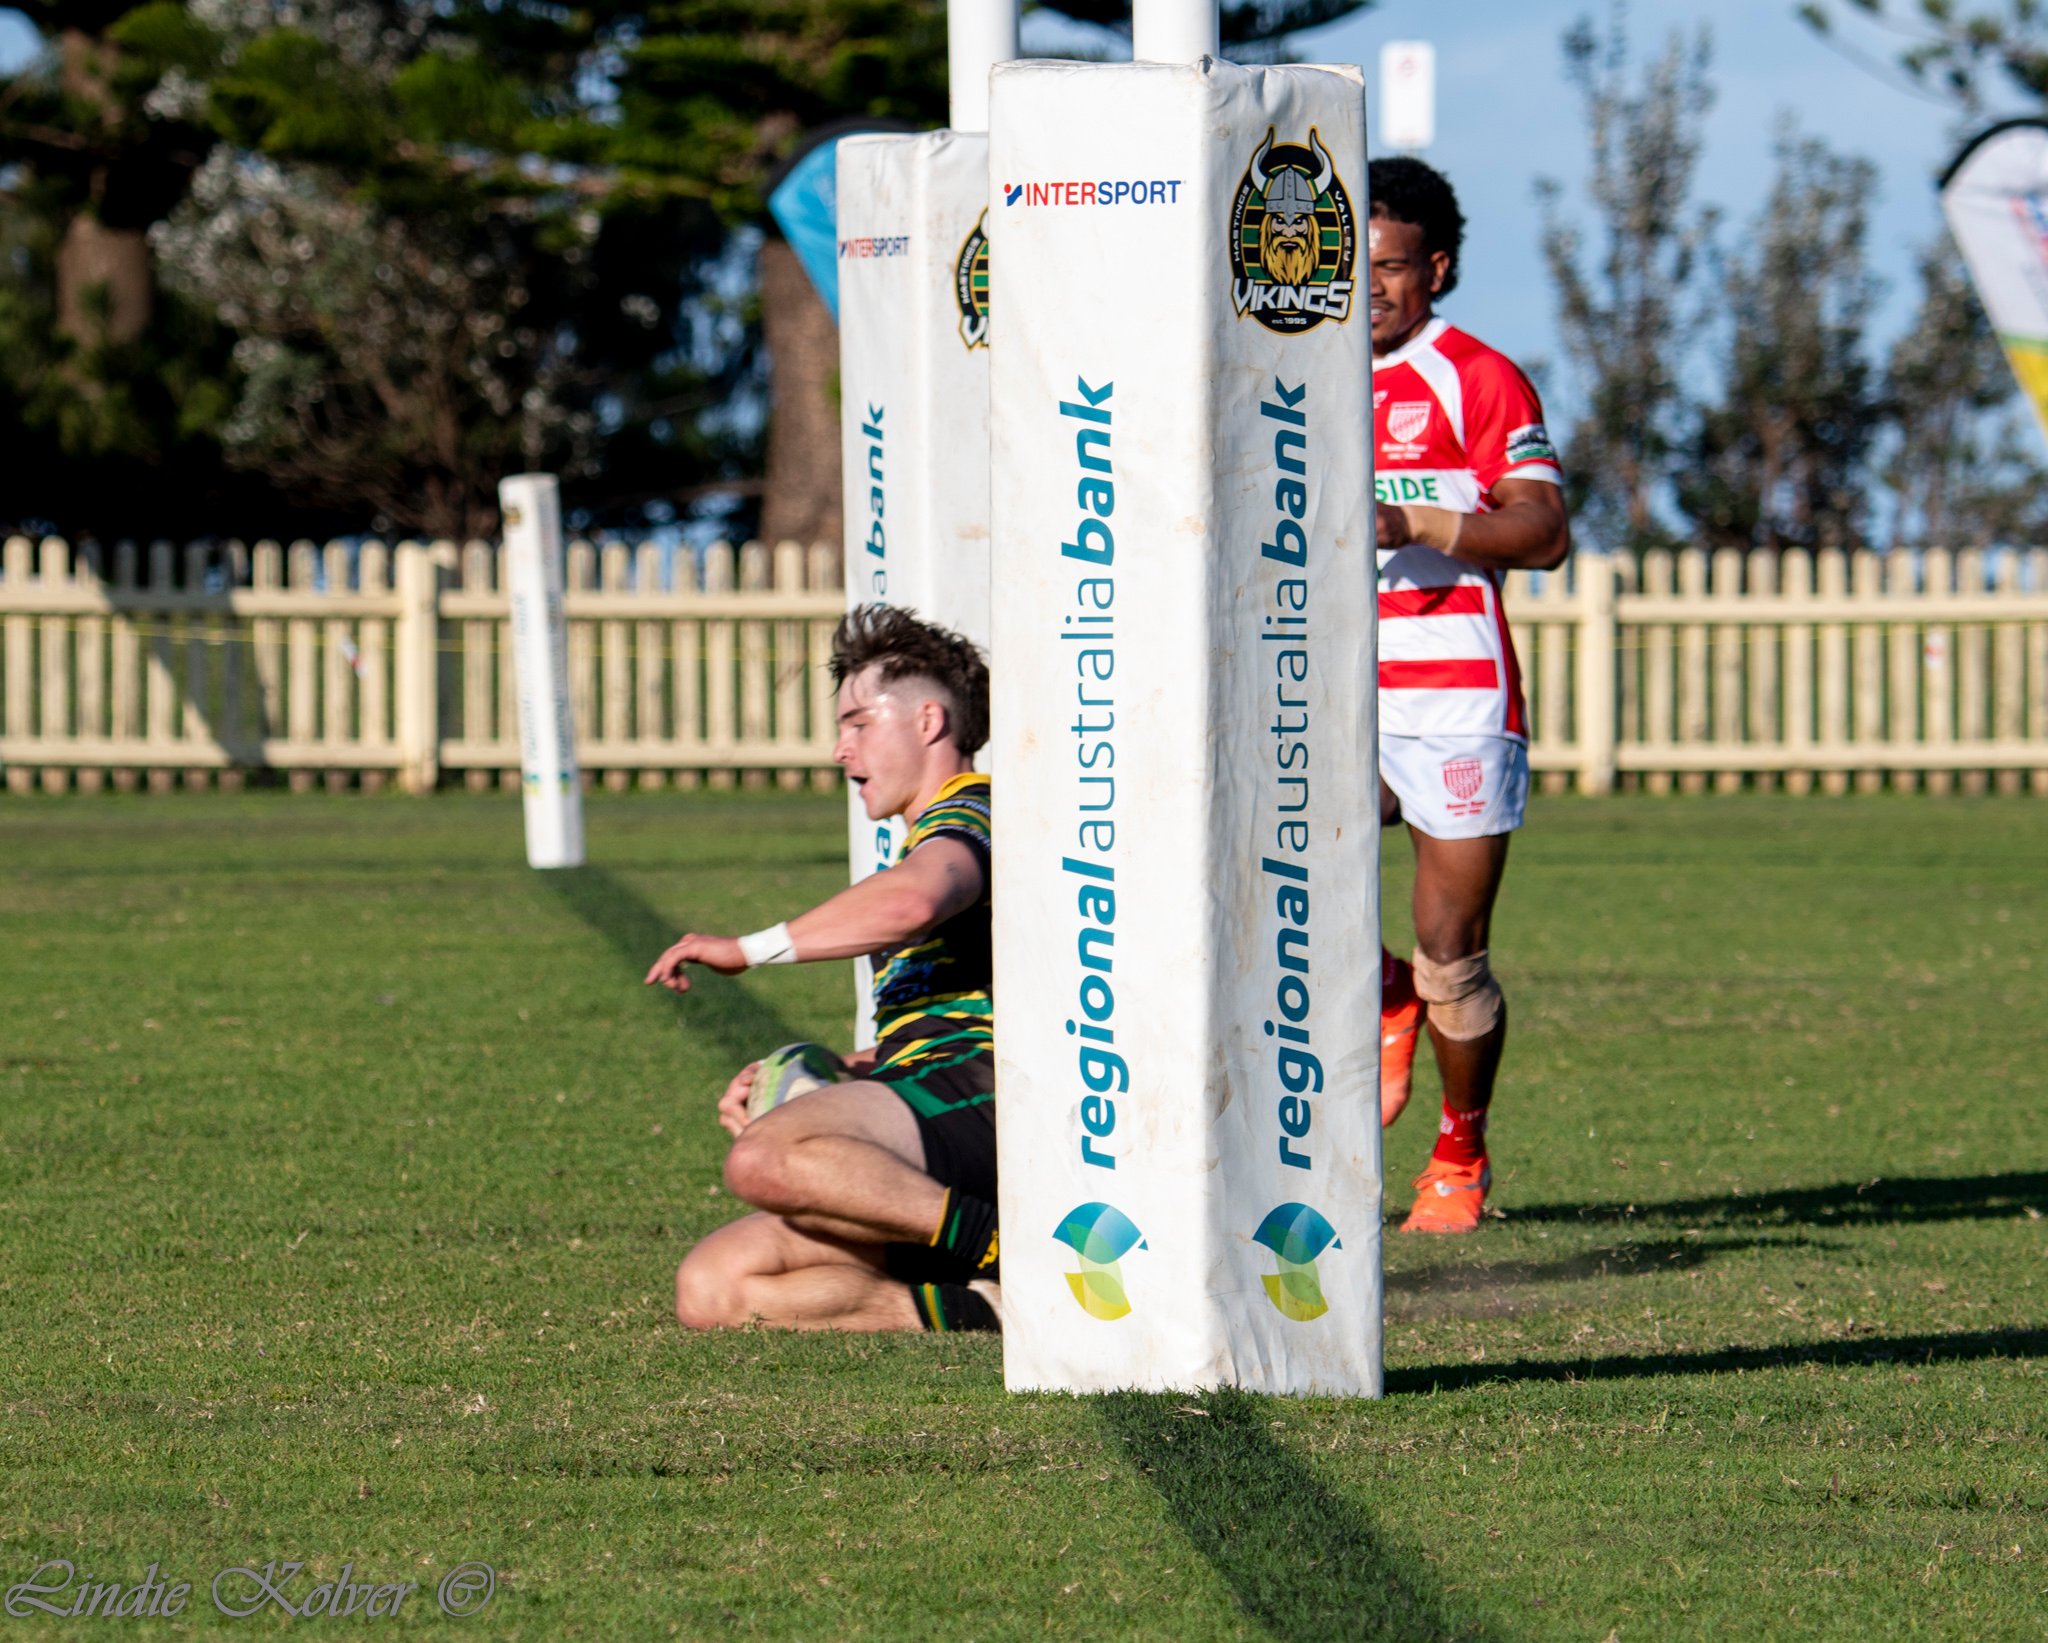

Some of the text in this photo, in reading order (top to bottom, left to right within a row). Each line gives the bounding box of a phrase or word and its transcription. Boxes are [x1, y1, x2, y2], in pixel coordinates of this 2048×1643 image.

[1026, 180, 1181, 206] INTERSPORT
[1233, 184, 1250, 262] HASTINGS
[1233, 277, 1352, 320] VIKINGS
